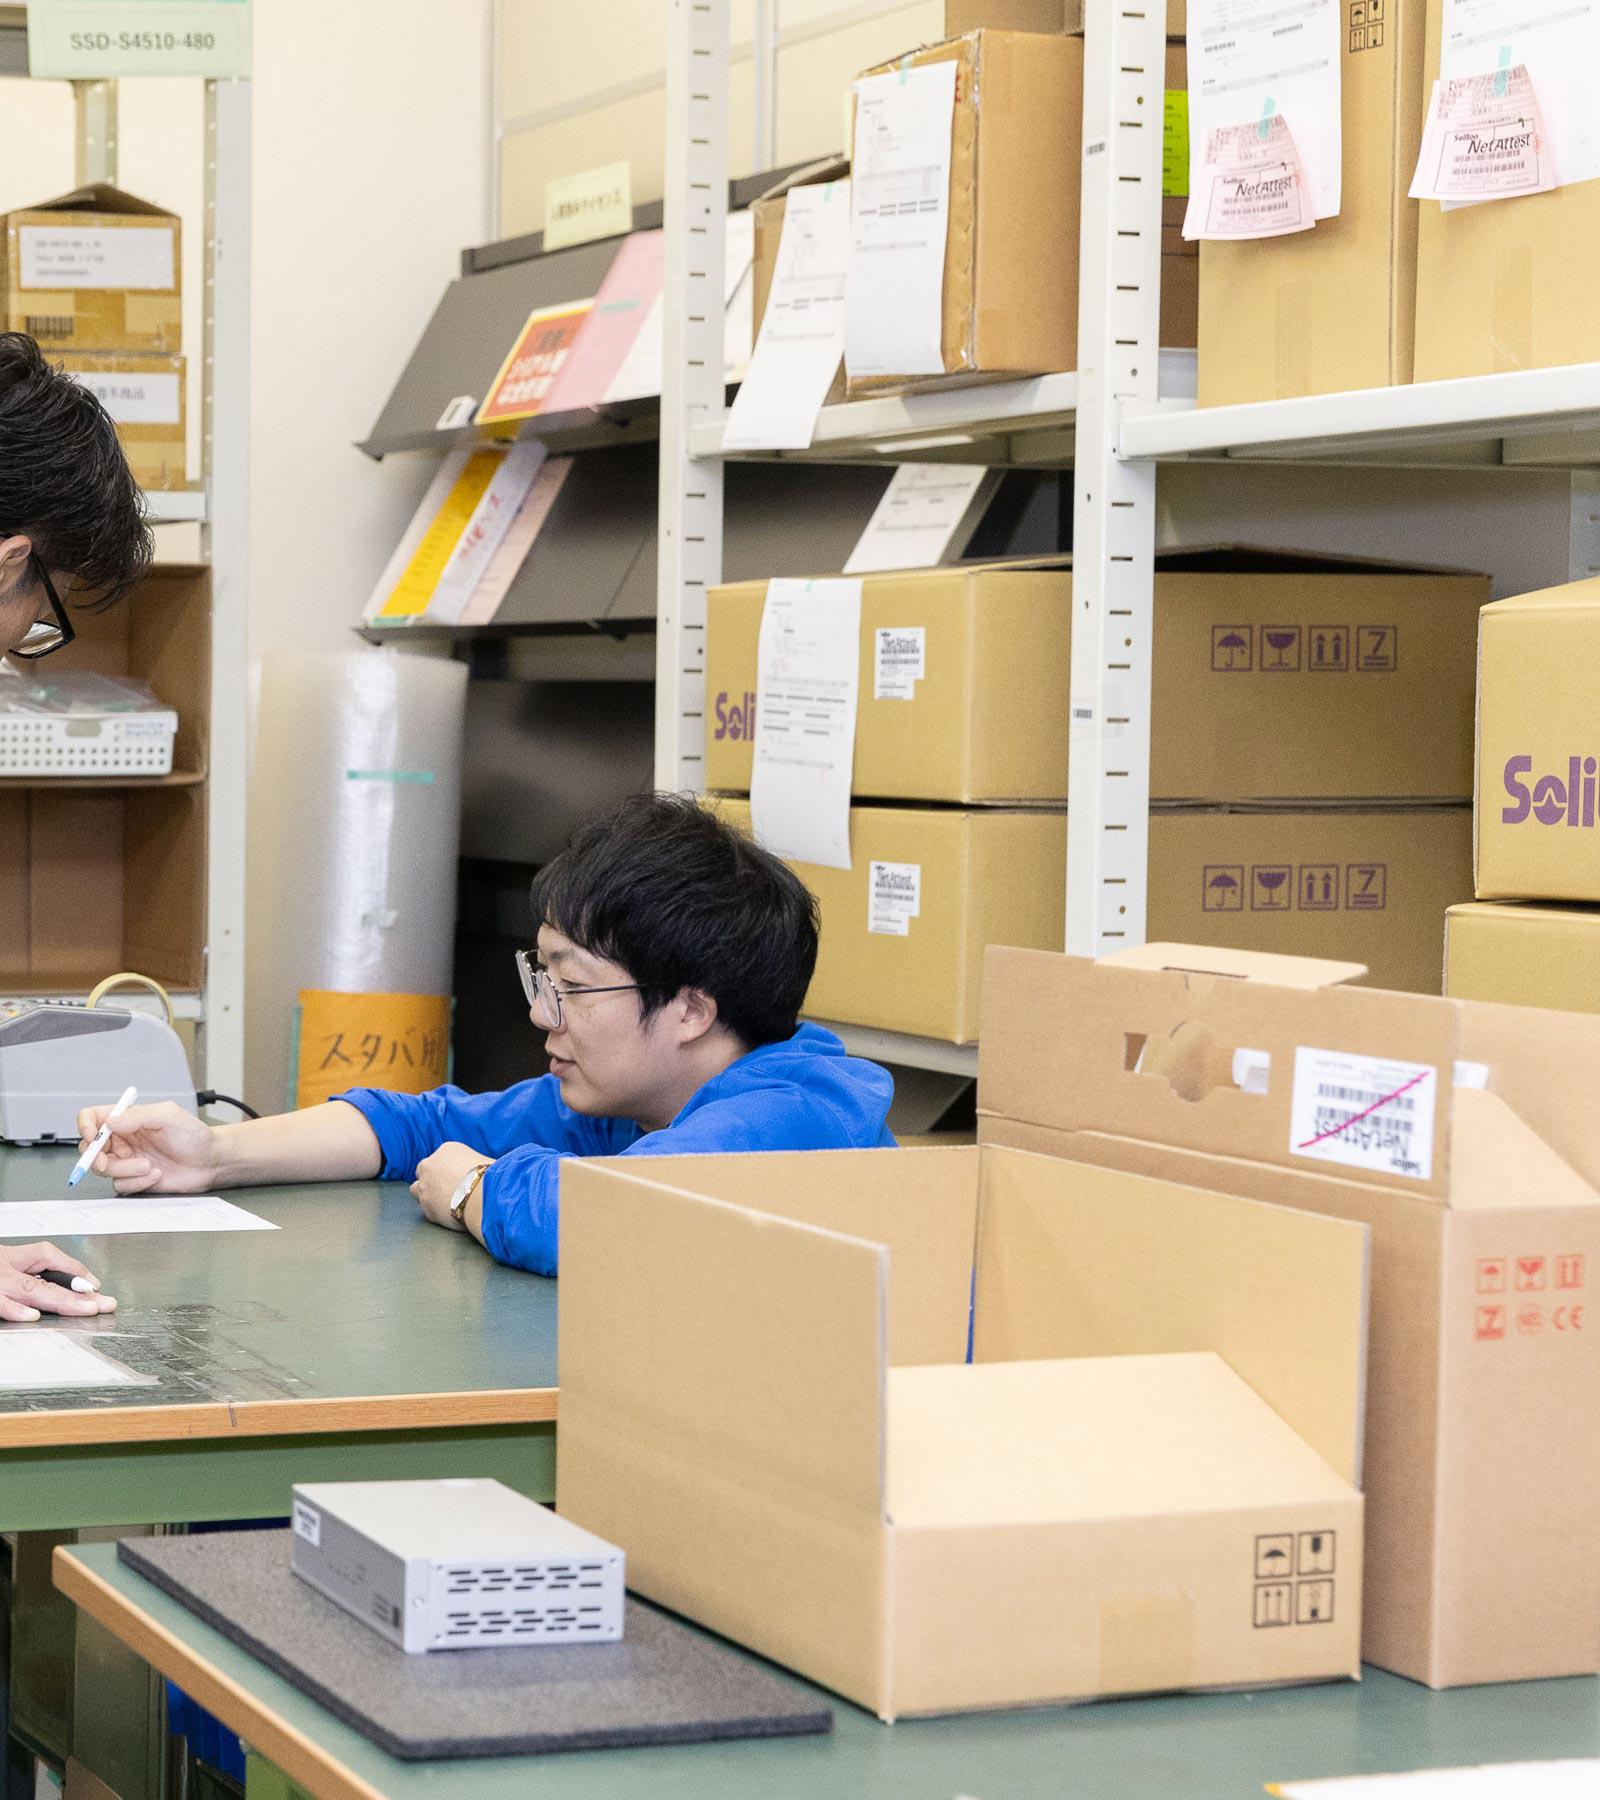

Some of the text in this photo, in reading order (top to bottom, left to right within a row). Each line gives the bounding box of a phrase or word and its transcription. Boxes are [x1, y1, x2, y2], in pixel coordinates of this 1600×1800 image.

[70, 32, 215, 50] SSD-S4510-480
[1467, 133, 1531, 155] NetAttest
[1235, 176, 1293, 197] NetAttest
[1502, 755, 1600, 828] Soli
[1314, 1119, 1409, 1158] NetAttest
